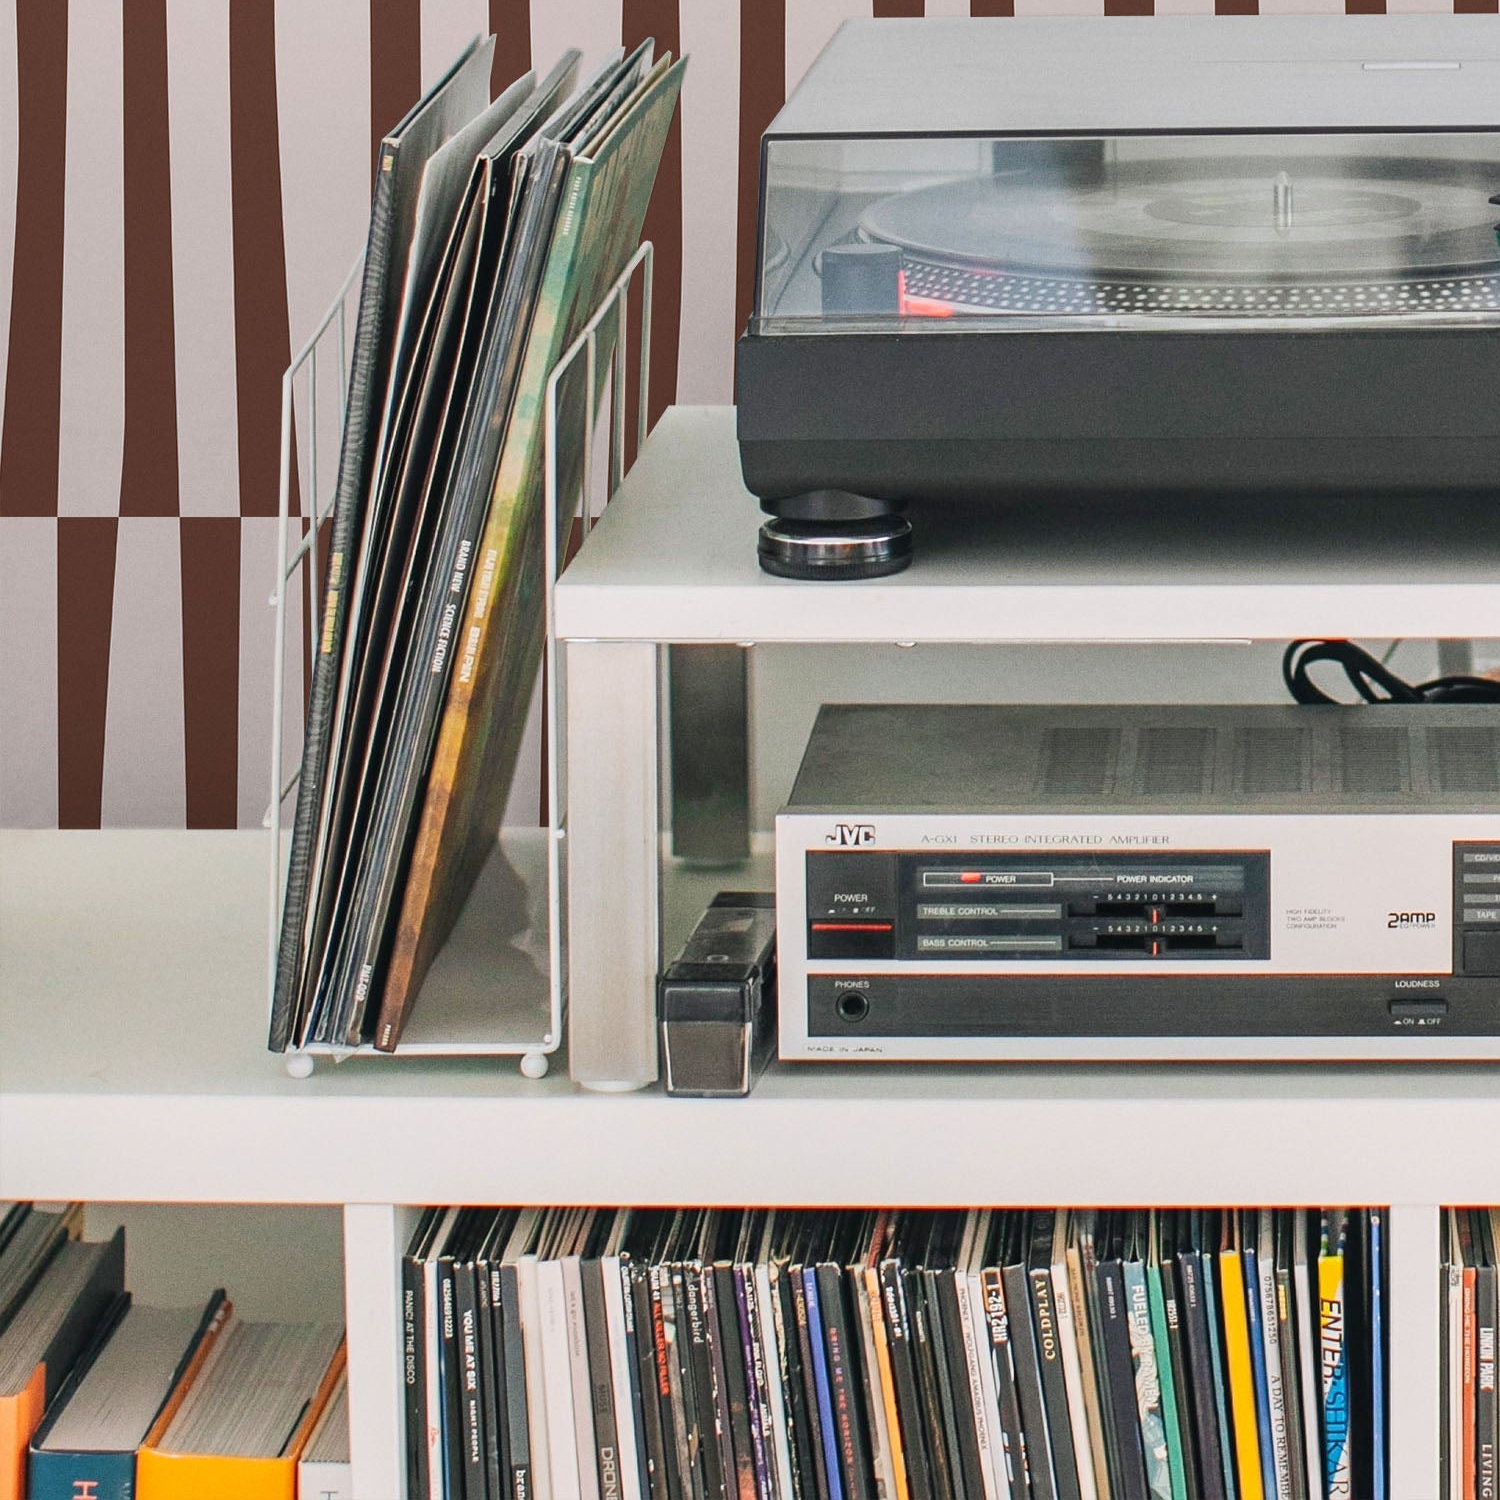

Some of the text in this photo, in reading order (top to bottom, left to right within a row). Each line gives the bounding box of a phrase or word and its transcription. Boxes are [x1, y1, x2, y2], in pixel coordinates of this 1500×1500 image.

[428, 539, 474, 674] BRAND NEW SCIENCE FICTION
[825, 824, 876, 846] JVC
[970, 834, 1018, 844] STEREO
[1025, 834, 1102, 845] INTEGRATED
[1109, 835, 1170, 845] AMPLIFIER
[986, 875, 1016, 883] POWER
[1117, 875, 1194, 883] POWER INDICATOR
[834, 894, 868, 903] POWER
[923, 907, 999, 916] TREBLE CONTROL
[1477, 911, 1497, 920] TAPE
[923, 939, 989, 948] BASS CONTROL
[354, 963, 372, 1002] PMT-009
[835, 980, 870, 989] PHONES
[1395, 980, 1440, 988] LOUDNESS
[687, 1284, 703, 1344] dangerbird
[986, 1283, 1009, 1344] HR2192-1
[1034, 1278, 1056, 1362] COLDPLAY
[1132, 1284, 1150, 1334] FUELED
[403, 1290, 418, 1385] PANIC! AT THE DISCO
[829, 1327, 841, 1362] BRING
[1462, 1287, 1474, 1384] BRING ME THE HORIZON
[834, 1367, 844, 1384] ME
[959, 1287, 970, 1322] PHOENIX
[976, 1416, 987, 1451] PHOENIX
[1271, 1375, 1281, 1384] A
[462, 1309, 480, 1463] YOU ME AT SIX NIGHT PEOPLE
[1140, 1359, 1159, 1409] RAMEN
[837, 1388, 847, 1410] THE
[1272, 1387, 1283, 1412] DAY
[1275, 1416, 1285, 1434] TO
[1478, 1327, 1497, 1499] LINKIN PARK LIVING
[840, 1413, 854, 1465] HORIZON
